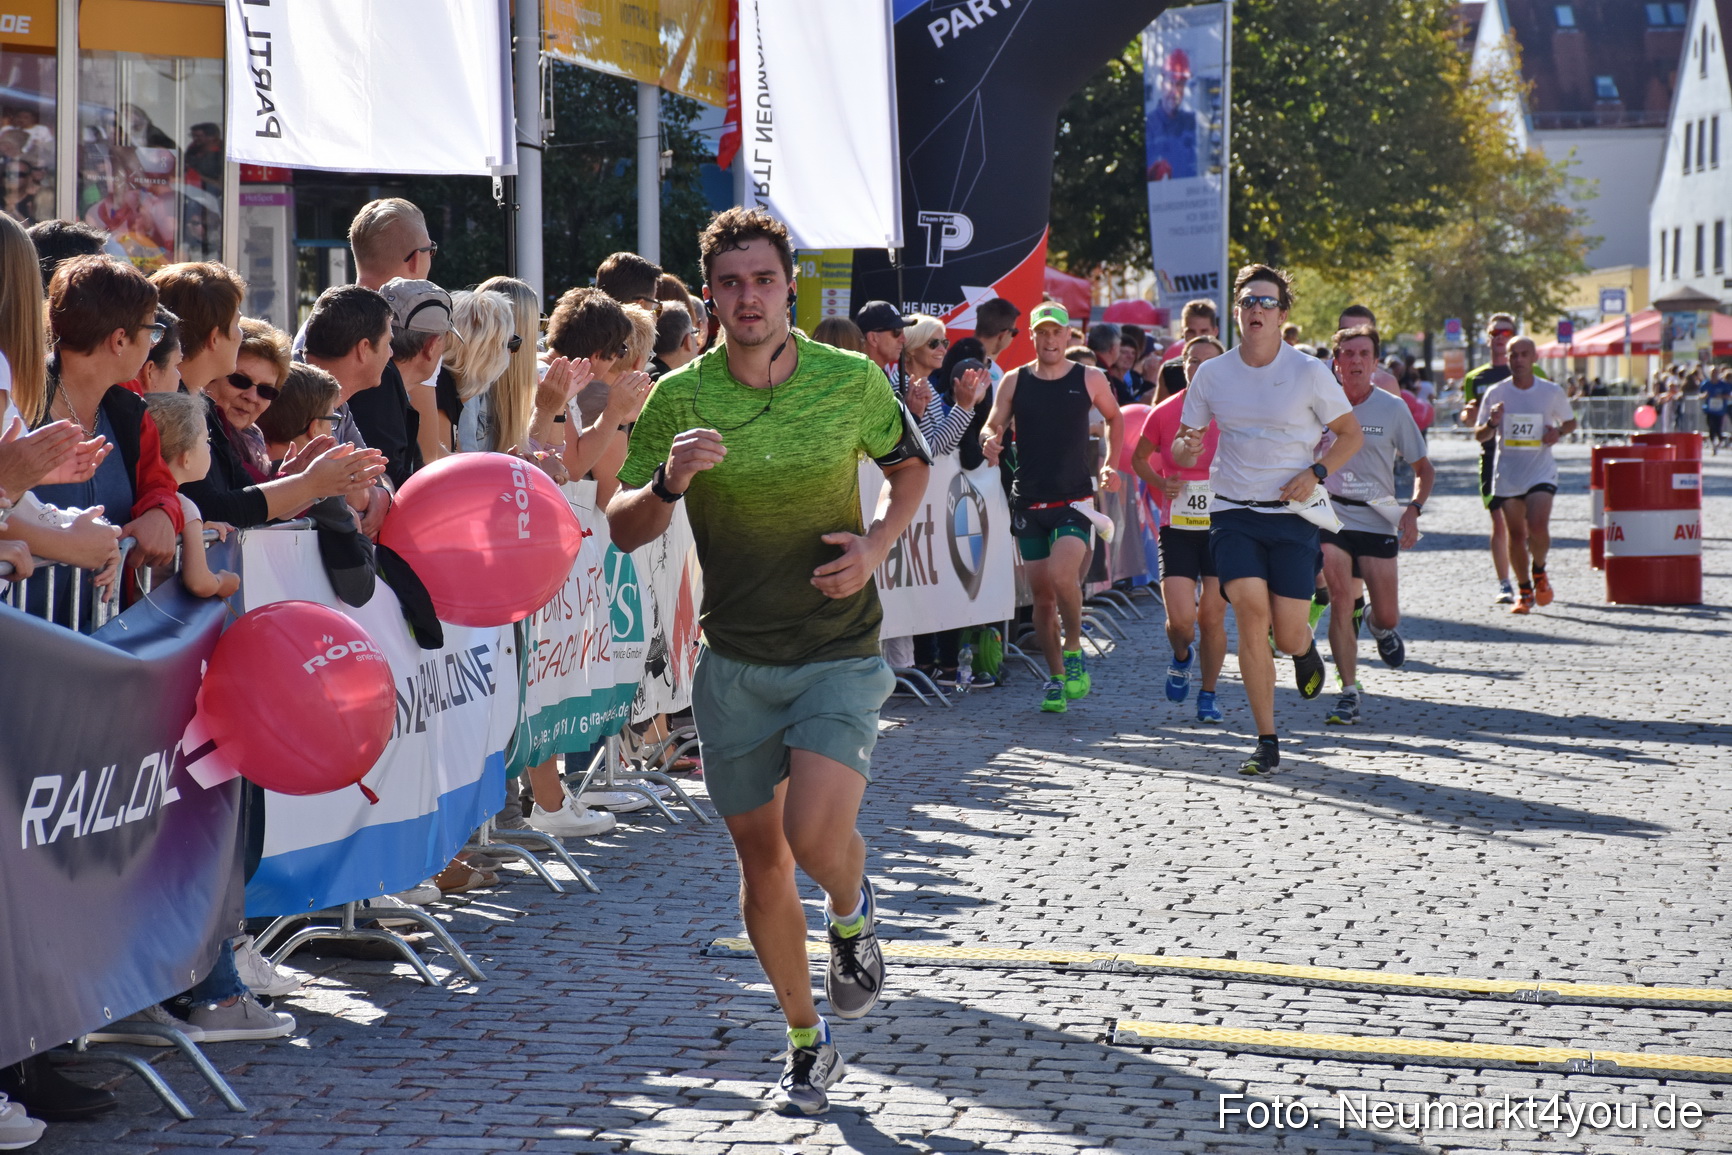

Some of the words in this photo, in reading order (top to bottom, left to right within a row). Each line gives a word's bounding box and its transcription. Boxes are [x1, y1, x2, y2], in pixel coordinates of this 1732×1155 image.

[921, 302, 955, 317] NEXT
[1512, 423, 1534, 435] 247
[1341, 472, 1357, 482] 19.
[1185, 517, 1210, 526] Tamara
[1674, 520, 1700, 541] AVI
